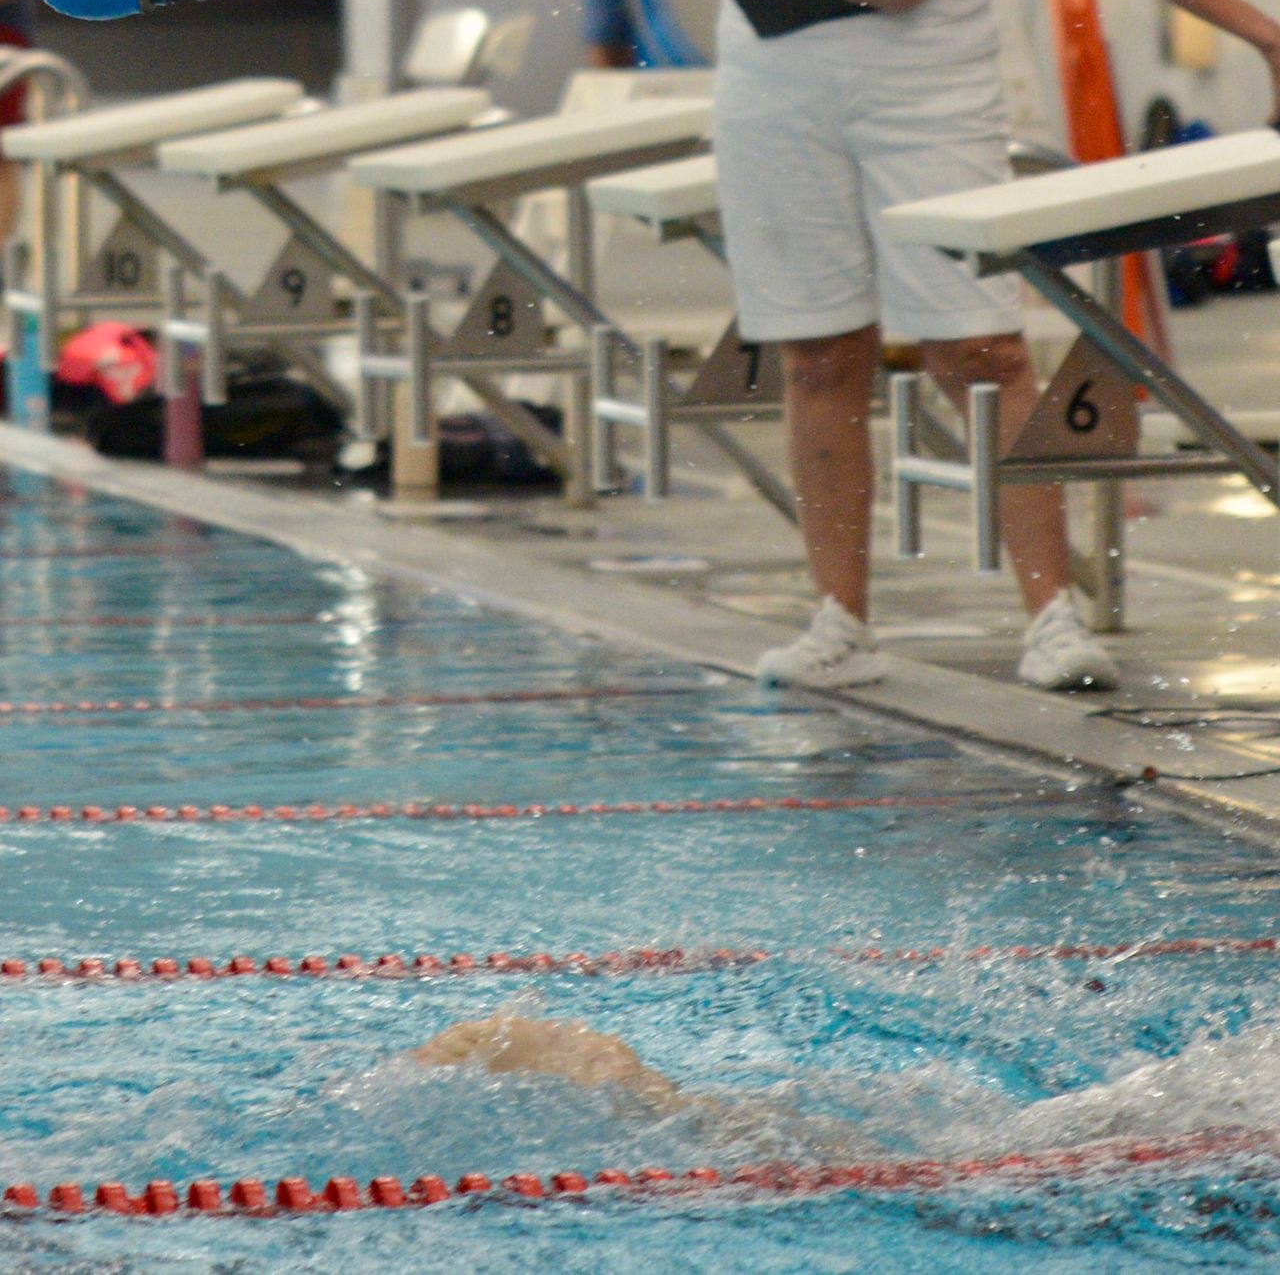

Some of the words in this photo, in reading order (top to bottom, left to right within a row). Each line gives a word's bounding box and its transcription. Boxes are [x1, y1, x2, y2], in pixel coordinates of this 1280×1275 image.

[103, 250, 141, 287] 10
[281, 268, 307, 308] 9
[492, 295, 513, 336] 8
[738, 340, 761, 392] 7
[1067, 379, 1100, 434] 6
